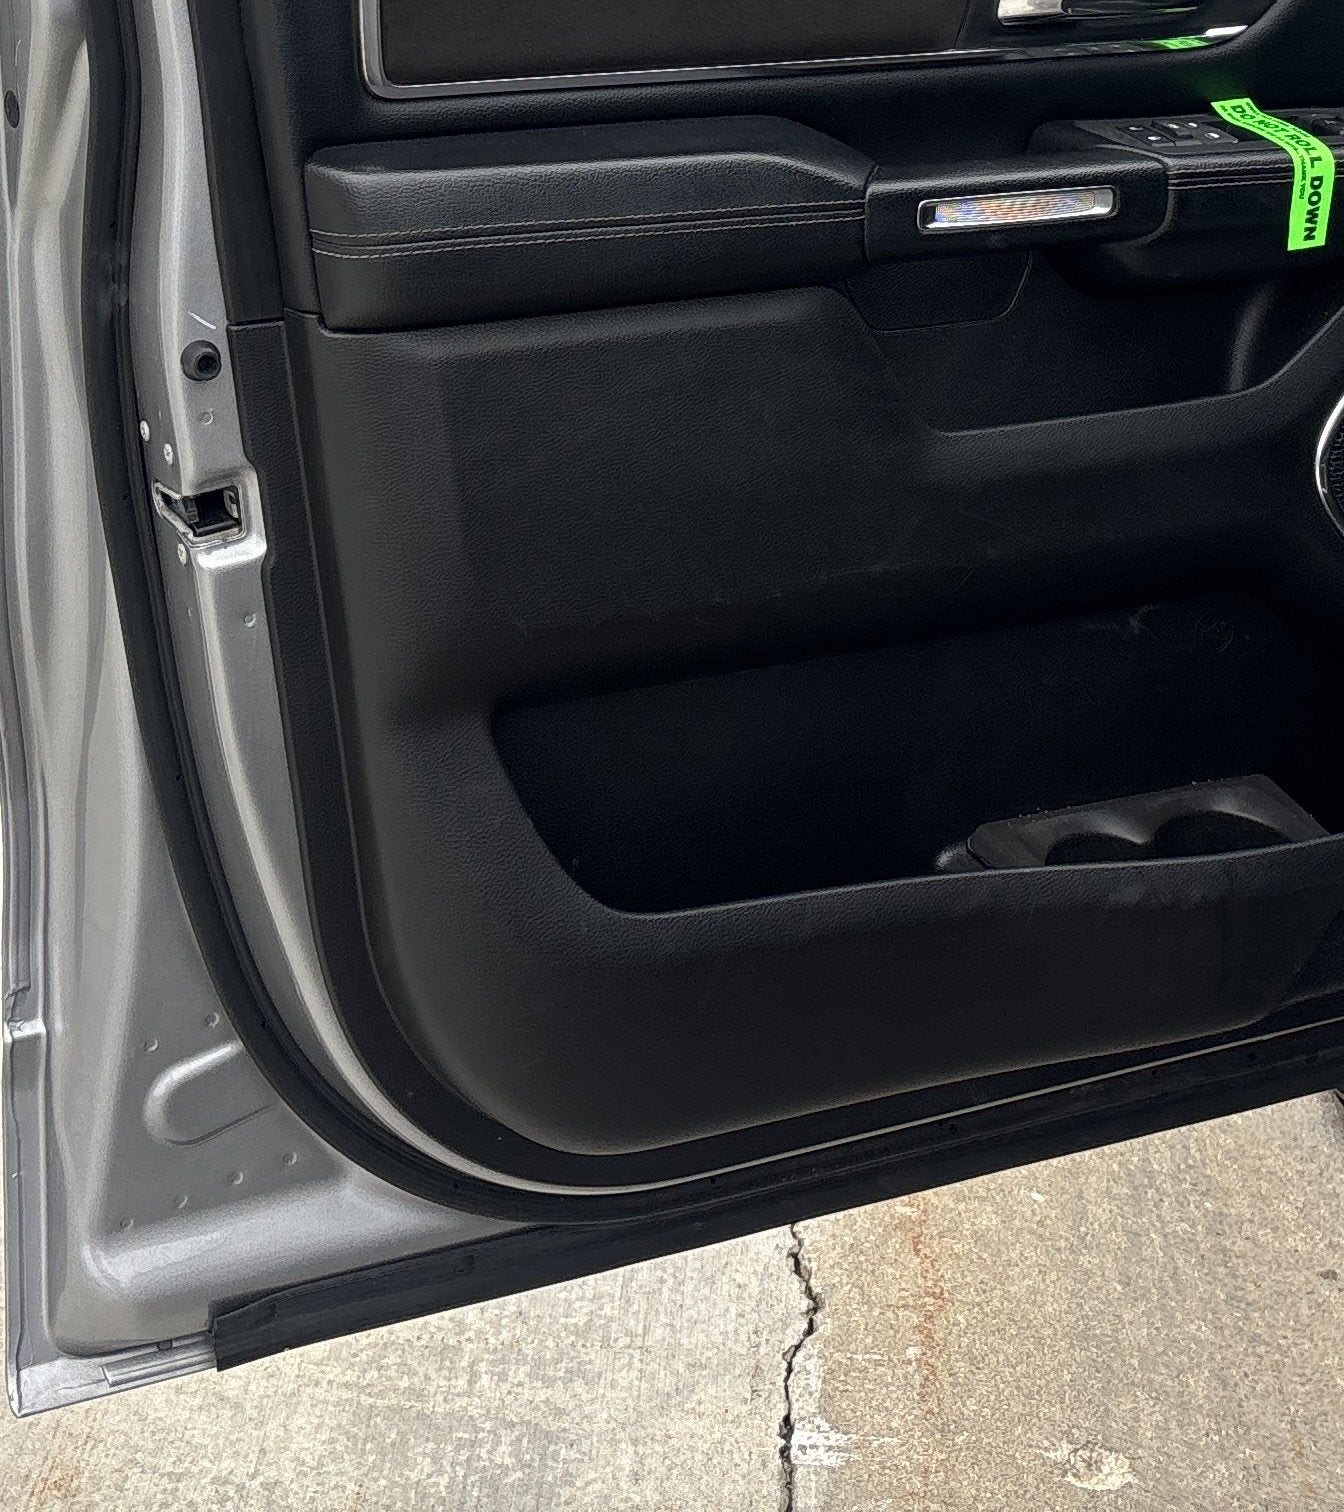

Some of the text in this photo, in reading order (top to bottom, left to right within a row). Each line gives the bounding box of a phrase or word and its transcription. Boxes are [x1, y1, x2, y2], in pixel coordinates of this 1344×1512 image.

[1229, 104, 1256, 120] DO
[1256, 118, 1290, 133] NOT
[1285, 133, 1323, 169] ROLL
[1302, 175, 1324, 242] DOWN
